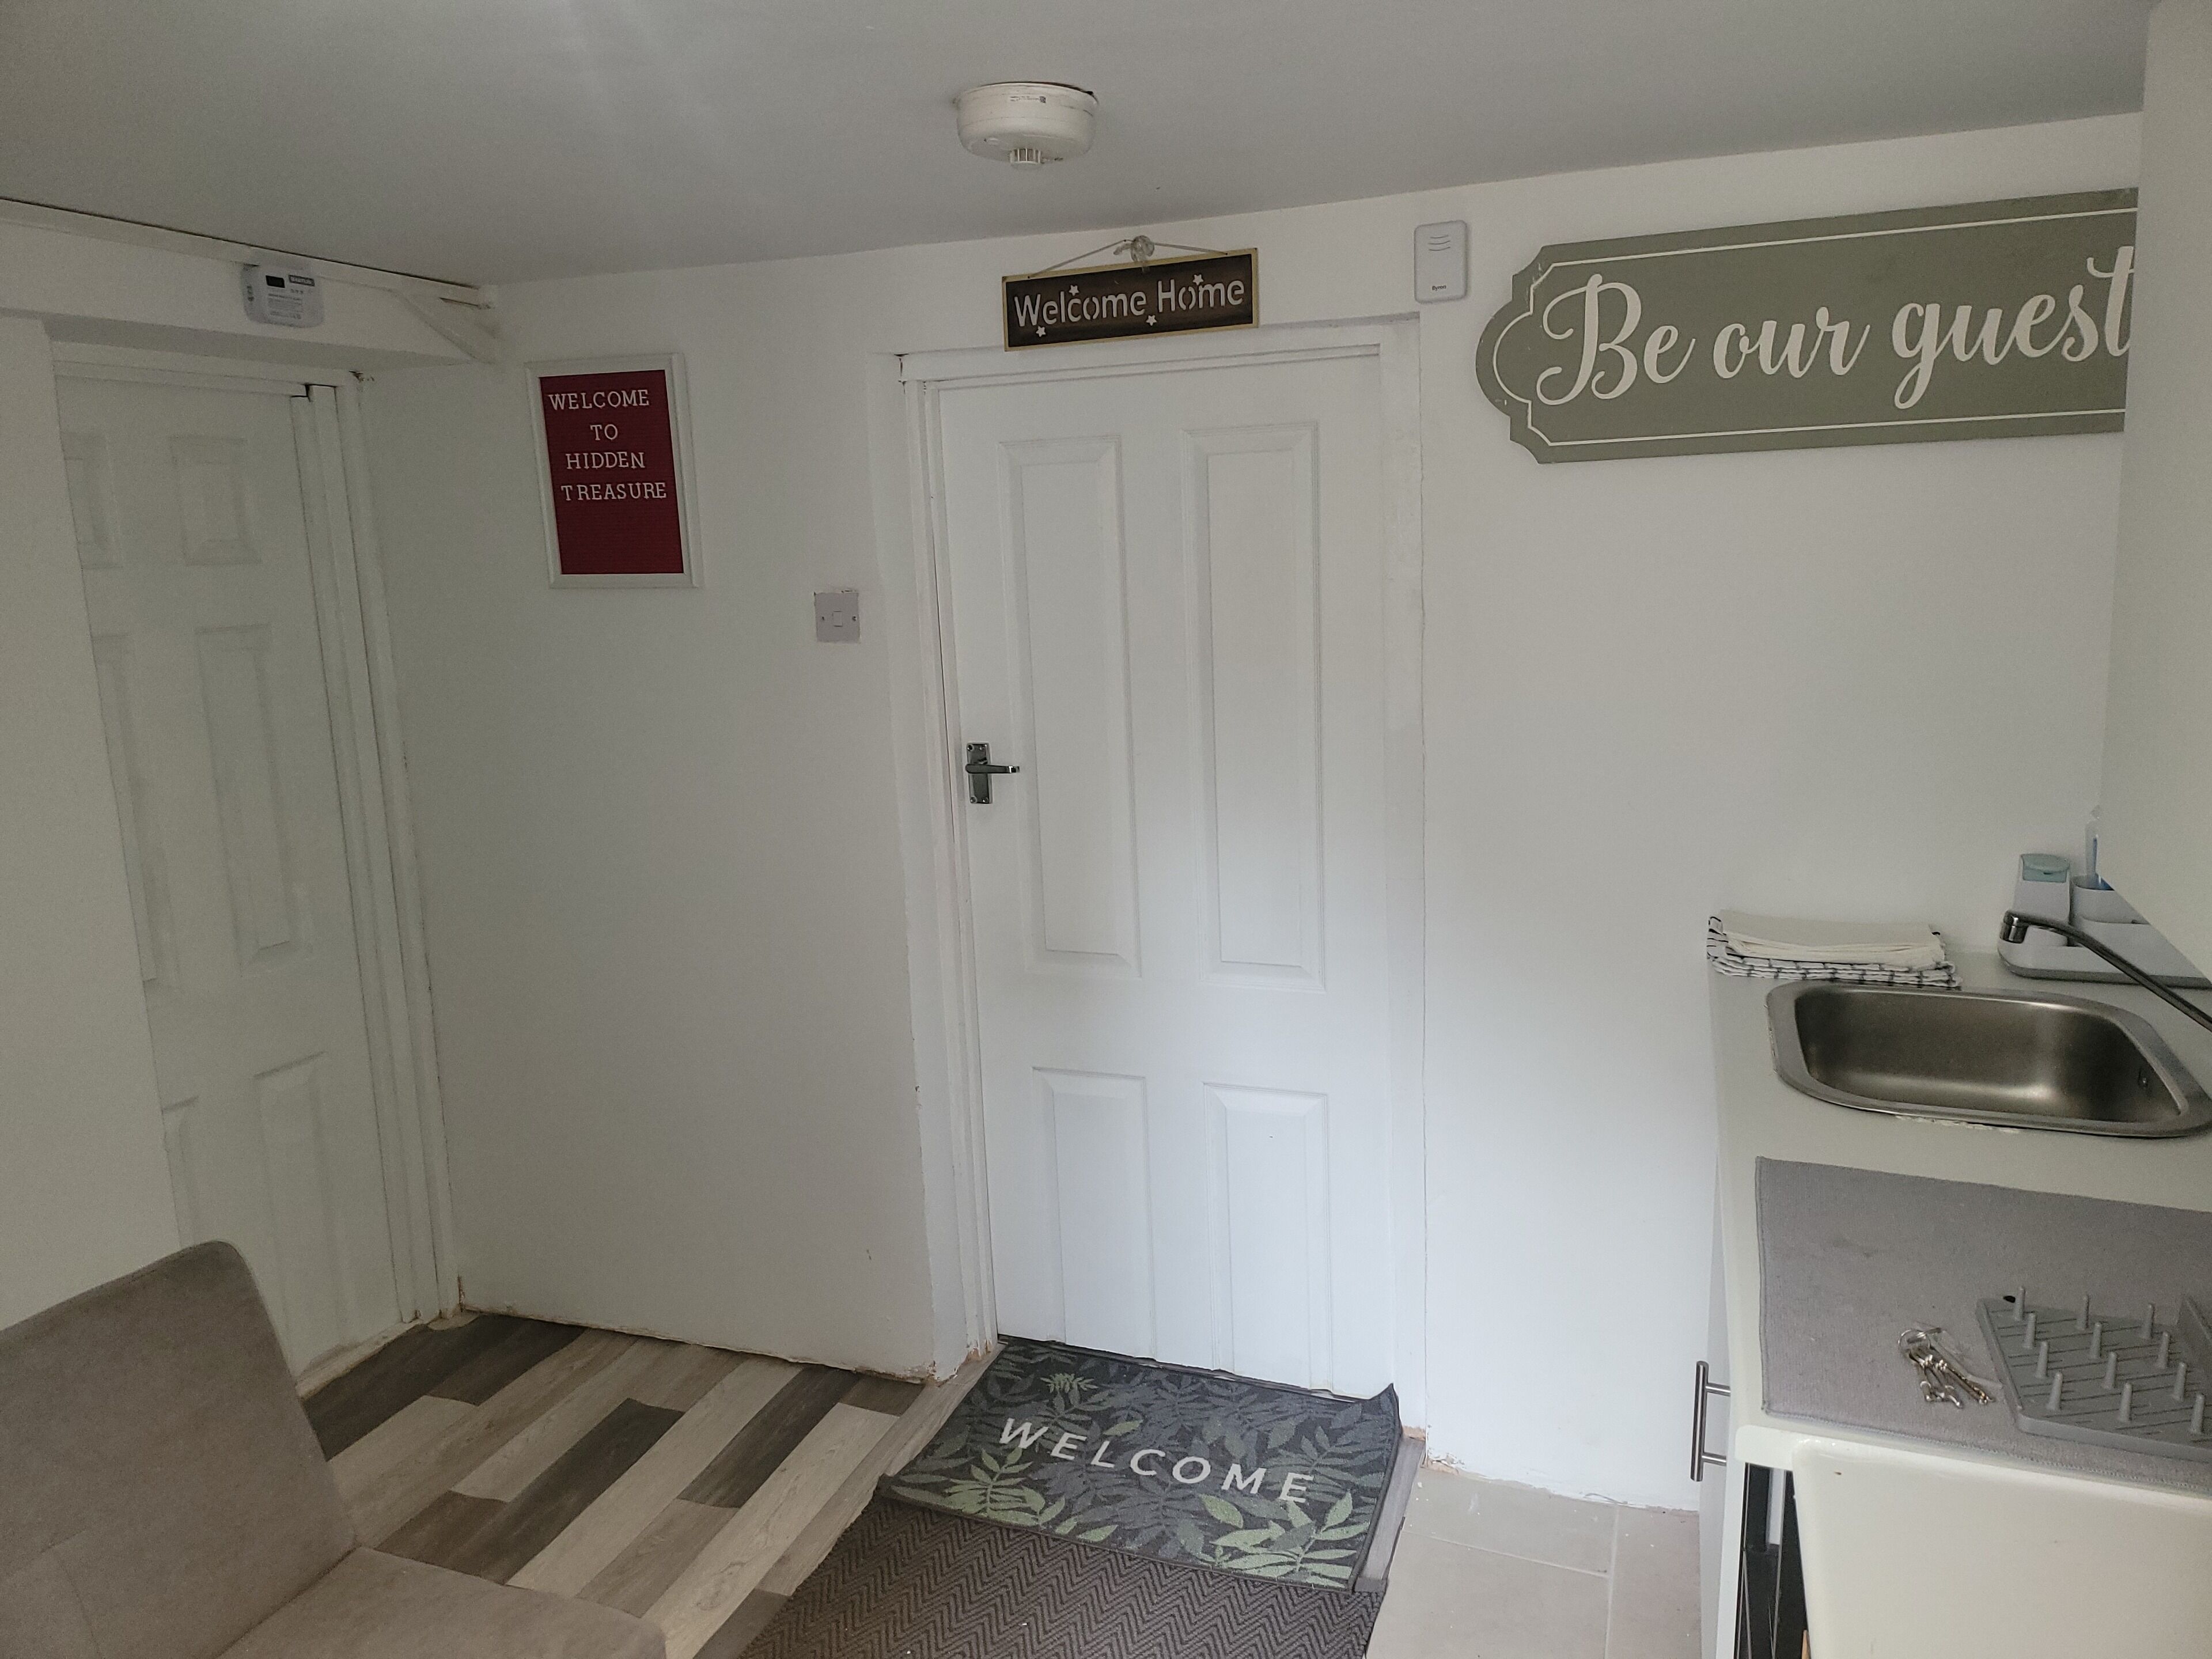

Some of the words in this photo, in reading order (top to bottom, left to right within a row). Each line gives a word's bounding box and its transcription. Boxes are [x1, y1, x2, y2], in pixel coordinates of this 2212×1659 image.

[1014, 291, 1146, 327] Welcome
[1158, 279, 1245, 313] Home
[1536, 274, 1695, 406] Be
[1713, 306, 1870, 378] our
[1891, 246, 2135, 410] guest
[548, 389, 649, 411] WELCOME
[590, 424, 618, 441] TO
[566, 452, 645, 469] HIDDEN
[561, 482, 666, 501] TREASURE
[1000, 1418, 1315, 1503] WELCOME
